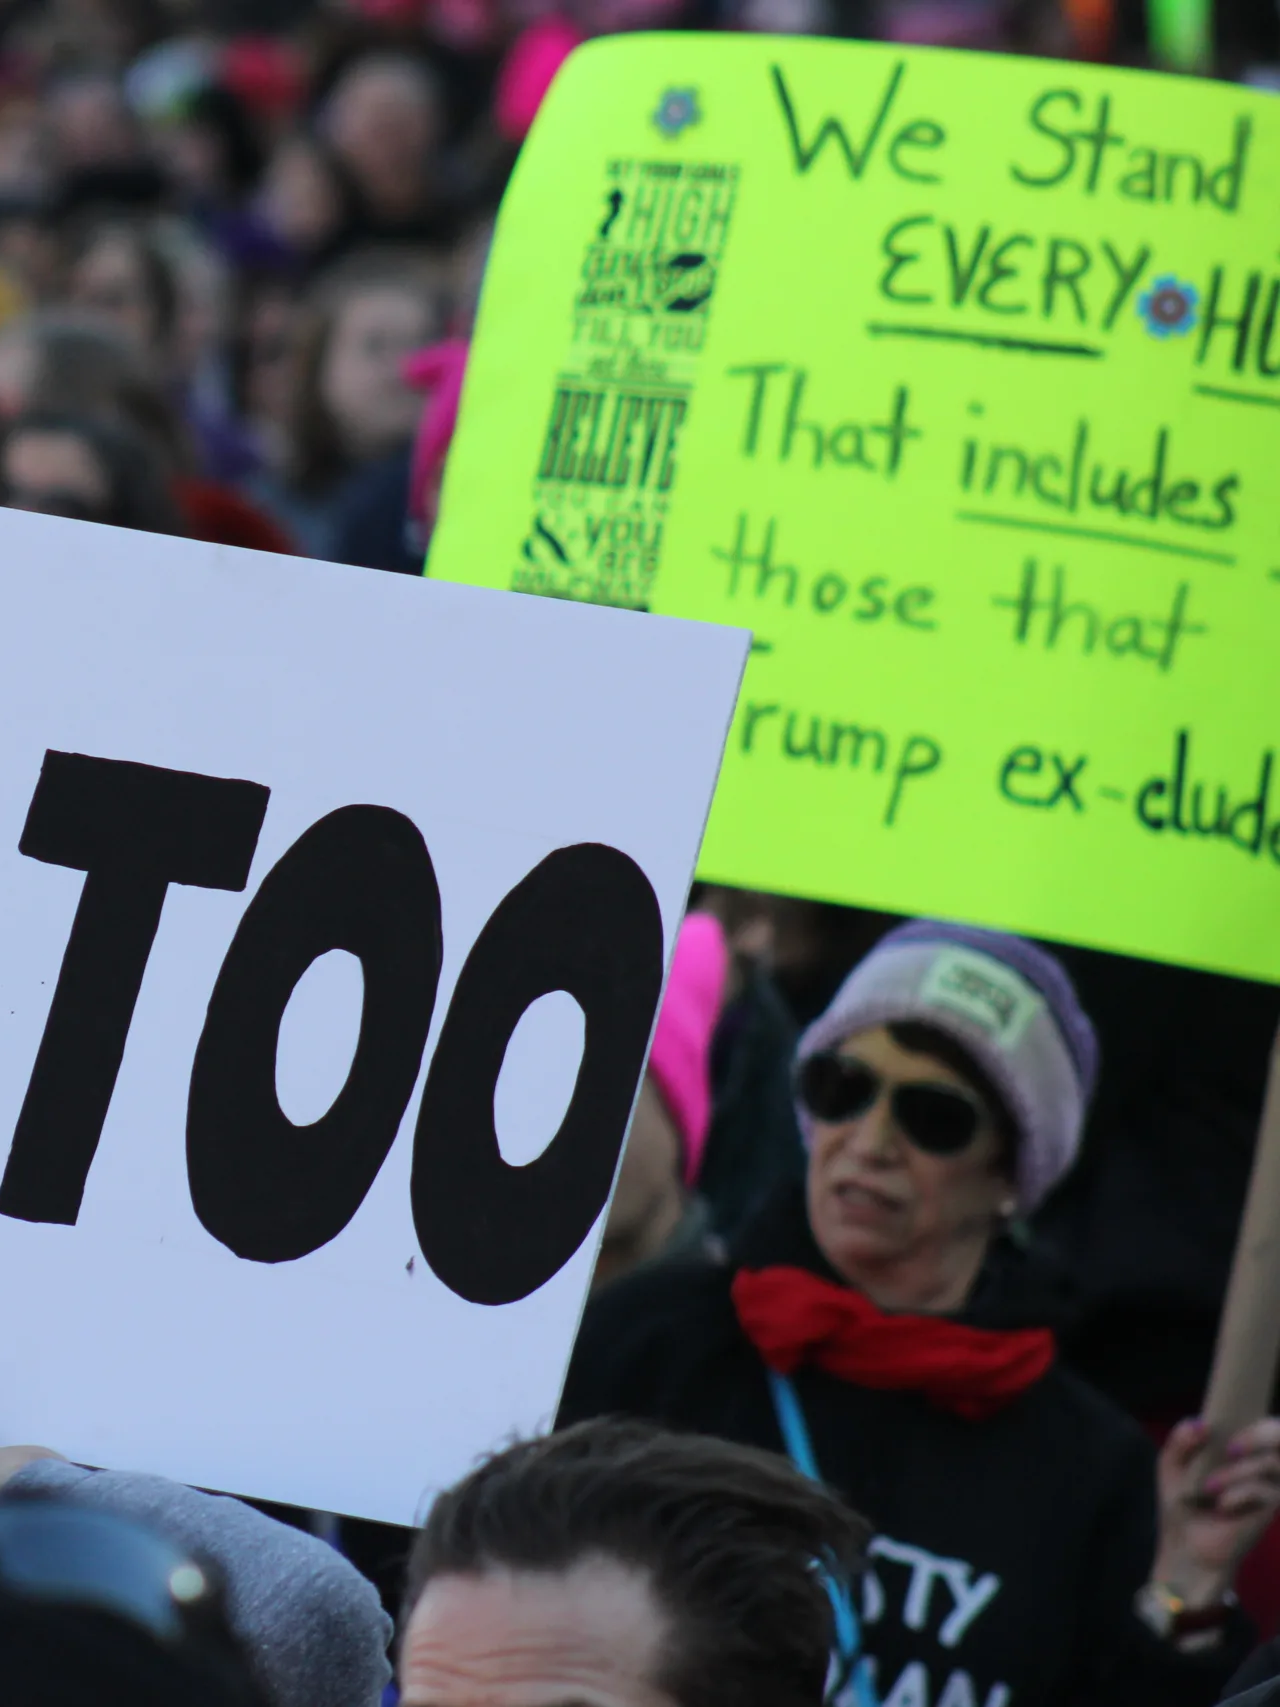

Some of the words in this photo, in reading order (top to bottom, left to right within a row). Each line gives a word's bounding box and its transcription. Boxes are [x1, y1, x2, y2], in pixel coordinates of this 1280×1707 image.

[770, 61, 947, 185] We
[1010, 87, 1252, 212] Stand
[626, 186, 738, 248] HIGH
[880, 216, 1150, 332] EVERY
[536, 388, 689, 492] BELIEVE
[727, 363, 921, 477] That
[960, 403, 1240, 530] includes
[710, 511, 938, 630] those
[990, 556, 1208, 672] that
[742, 638, 942, 828] rump
